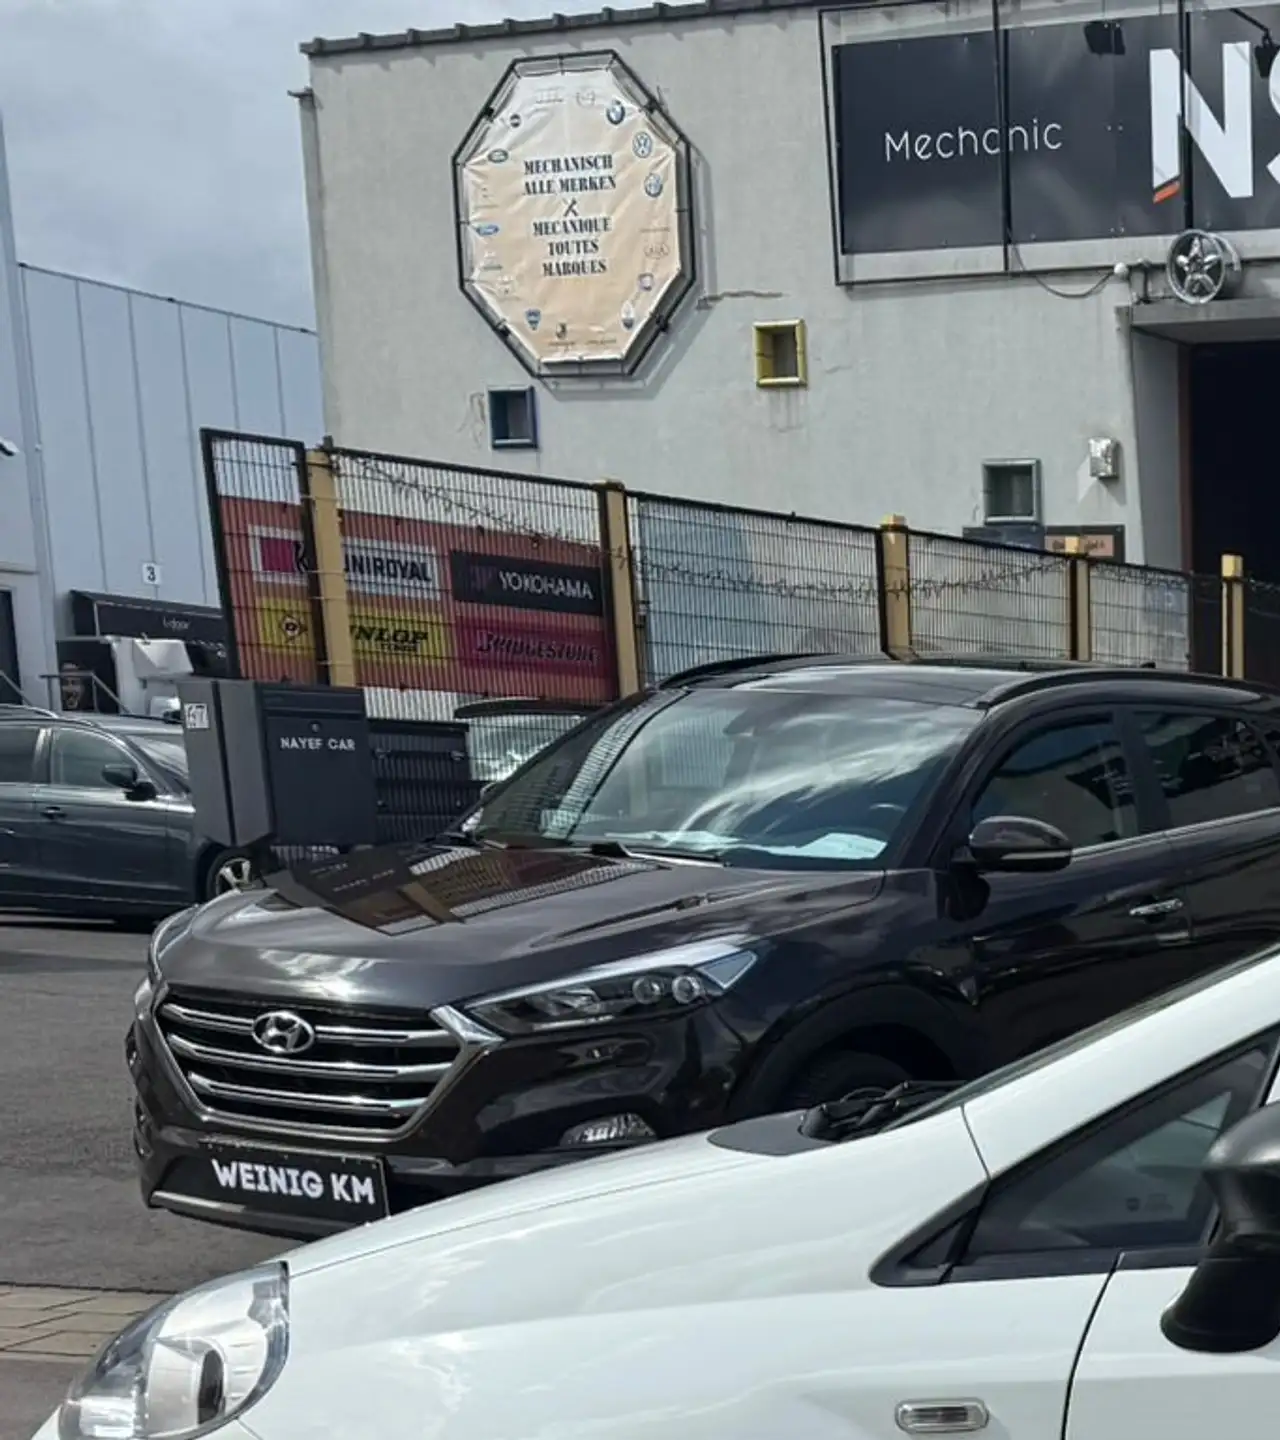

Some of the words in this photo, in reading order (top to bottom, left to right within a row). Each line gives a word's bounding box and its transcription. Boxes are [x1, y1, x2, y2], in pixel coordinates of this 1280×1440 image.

[884, 116, 1063, 163] Mechanic
[524, 154, 613, 175] MECHANISCH
[522, 180, 556, 196] ALLE
[559, 175, 616, 193] MERKEN
[532, 216, 612, 237] MECANIQUE
[548, 239, 599, 257] TOUTES
[542, 259, 607, 277] MARQUES
[146, 565, 156, 582] 3
[499, 570, 595, 601] YOKOHAMA
[350, 624, 429, 645] NLOP
[280, 737, 322, 750] NAYEF
[328, 737, 356, 752] CAR
[211, 1158, 324, 1199] WEINIG
[330, 1172, 376, 1205] KM
